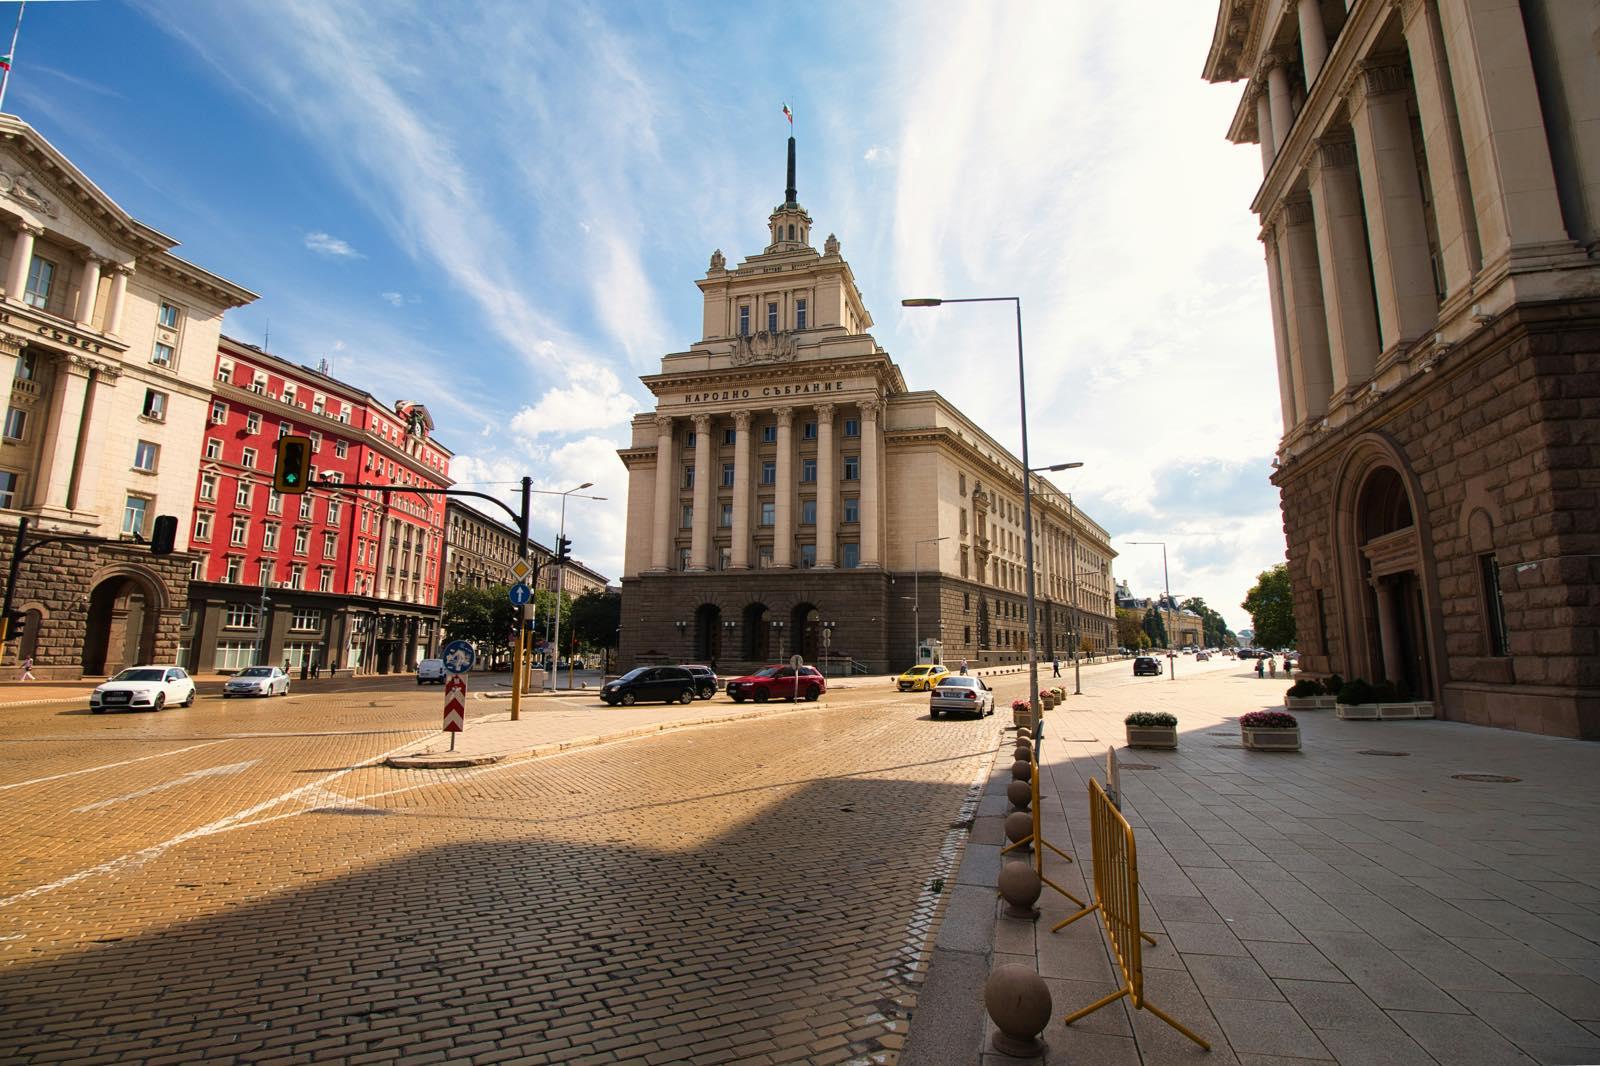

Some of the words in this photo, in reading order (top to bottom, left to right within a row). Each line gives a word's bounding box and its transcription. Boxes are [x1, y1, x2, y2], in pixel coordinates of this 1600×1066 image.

[38, 326, 102, 353] СЪВЕТ
[685, 389, 749, 403] НАРОДНО
[762, 381, 843, 396] СЪБРАНИЕ
